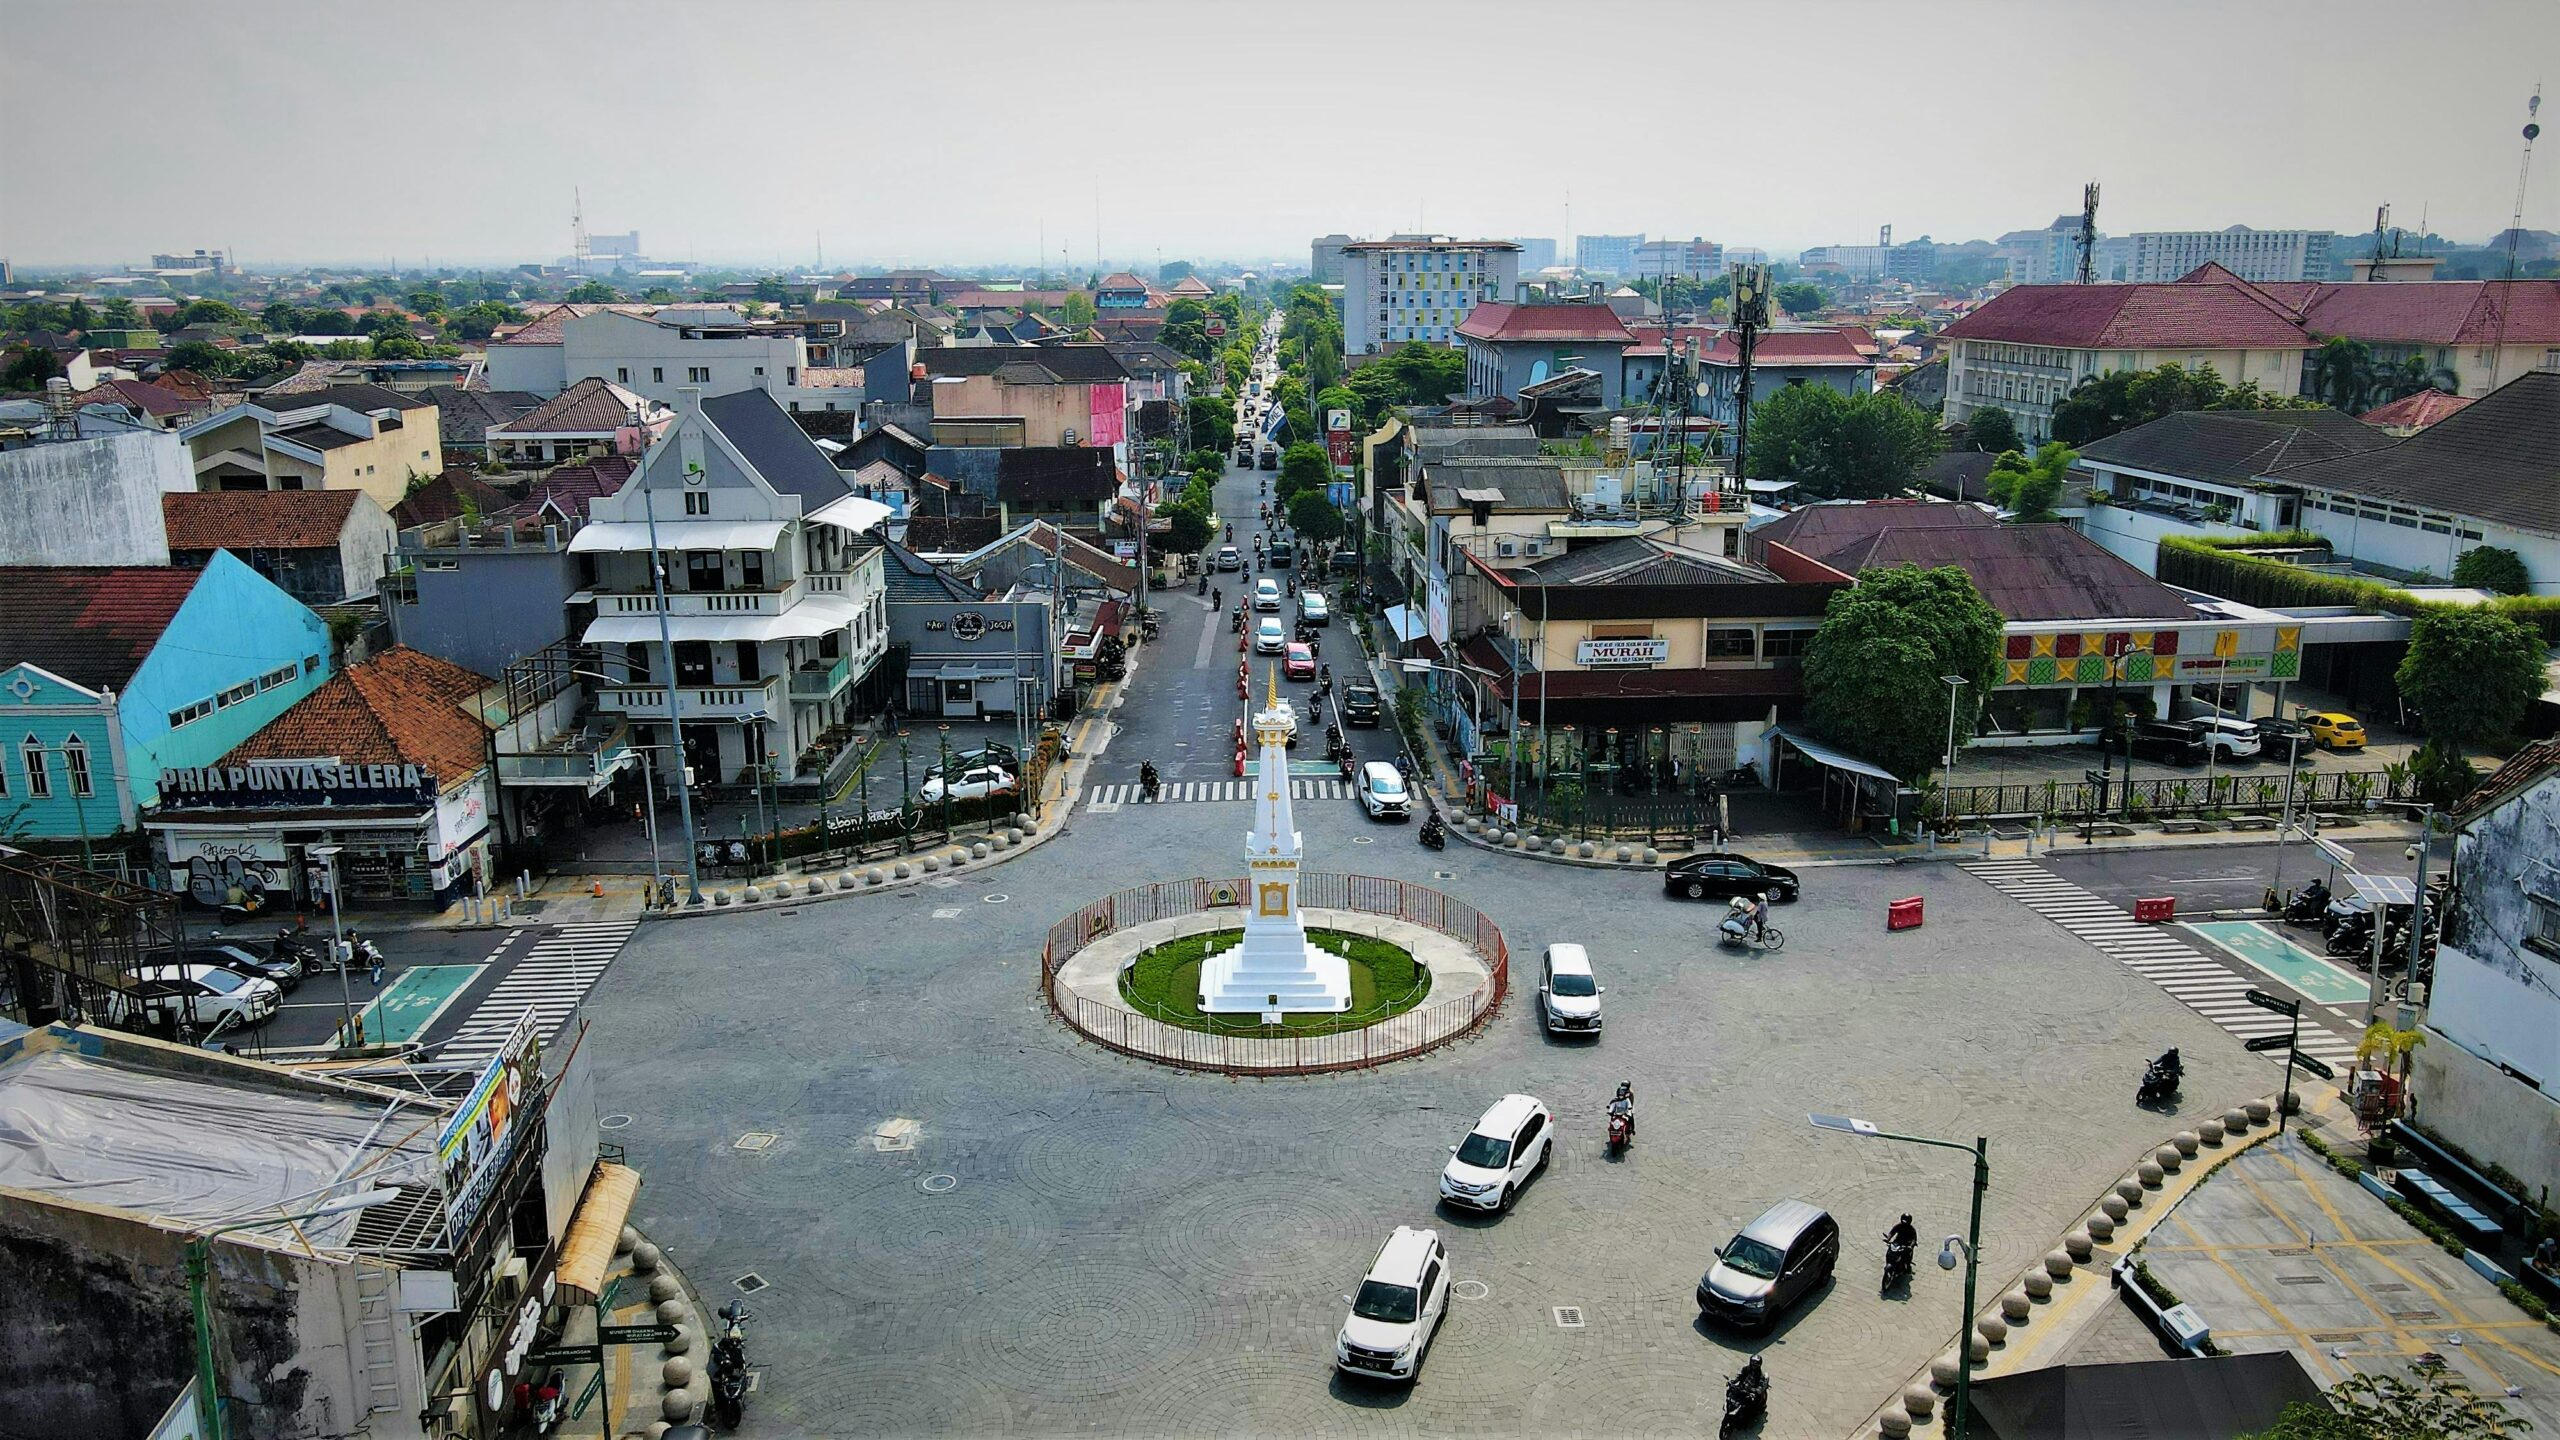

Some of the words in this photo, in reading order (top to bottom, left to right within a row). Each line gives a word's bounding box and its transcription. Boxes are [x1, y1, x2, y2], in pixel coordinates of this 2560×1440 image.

[1592, 647, 1654, 657] MURAH
[160, 767, 225, 793] PRIA
[228, 765, 321, 792] PUNYA
[321, 763, 422, 790] SELERA
